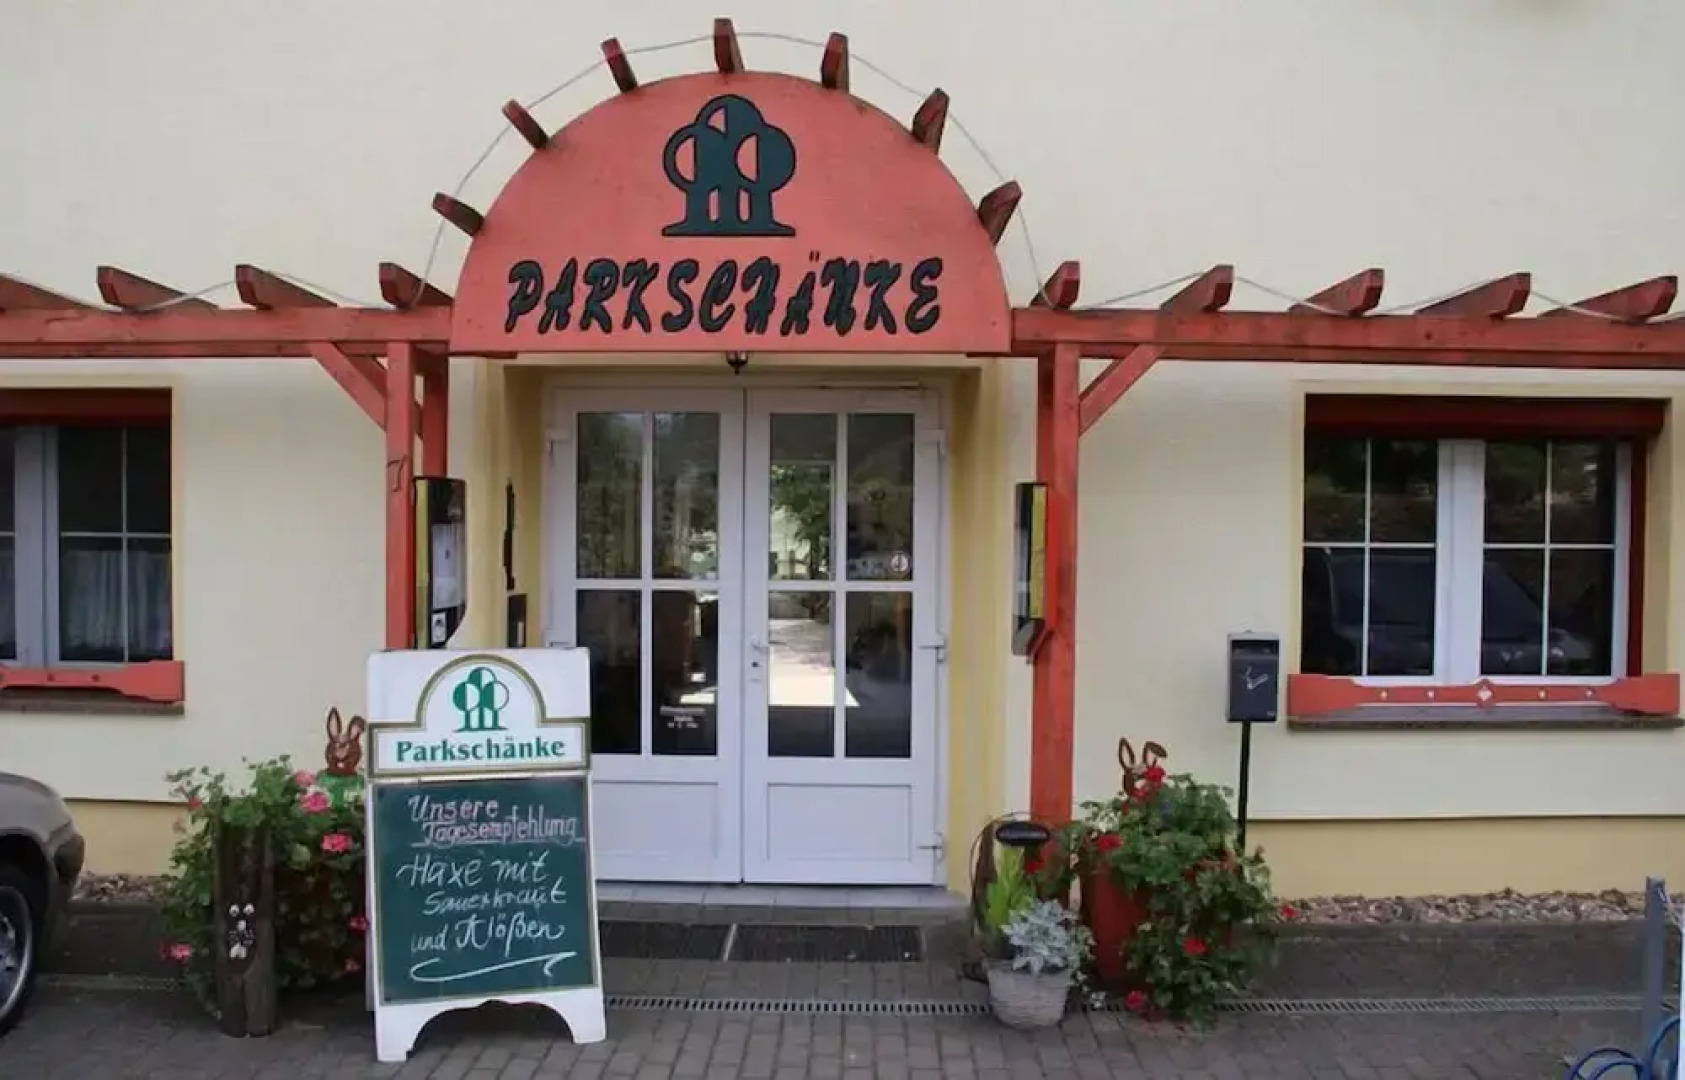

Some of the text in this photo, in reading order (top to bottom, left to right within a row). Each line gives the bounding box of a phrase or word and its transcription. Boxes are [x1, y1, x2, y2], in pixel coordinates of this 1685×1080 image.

[504, 250, 943, 336] PARKSCHÄNKE
[396, 735, 566, 763] Parkschänke
[408, 795, 499, 823] Unsere
[420, 804, 579, 846] Tagesempfehlung
[396, 850, 550, 887] Haxe mit
[422, 875, 567, 915] Sauerkraut
[410, 911, 566, 958] und Klößen
